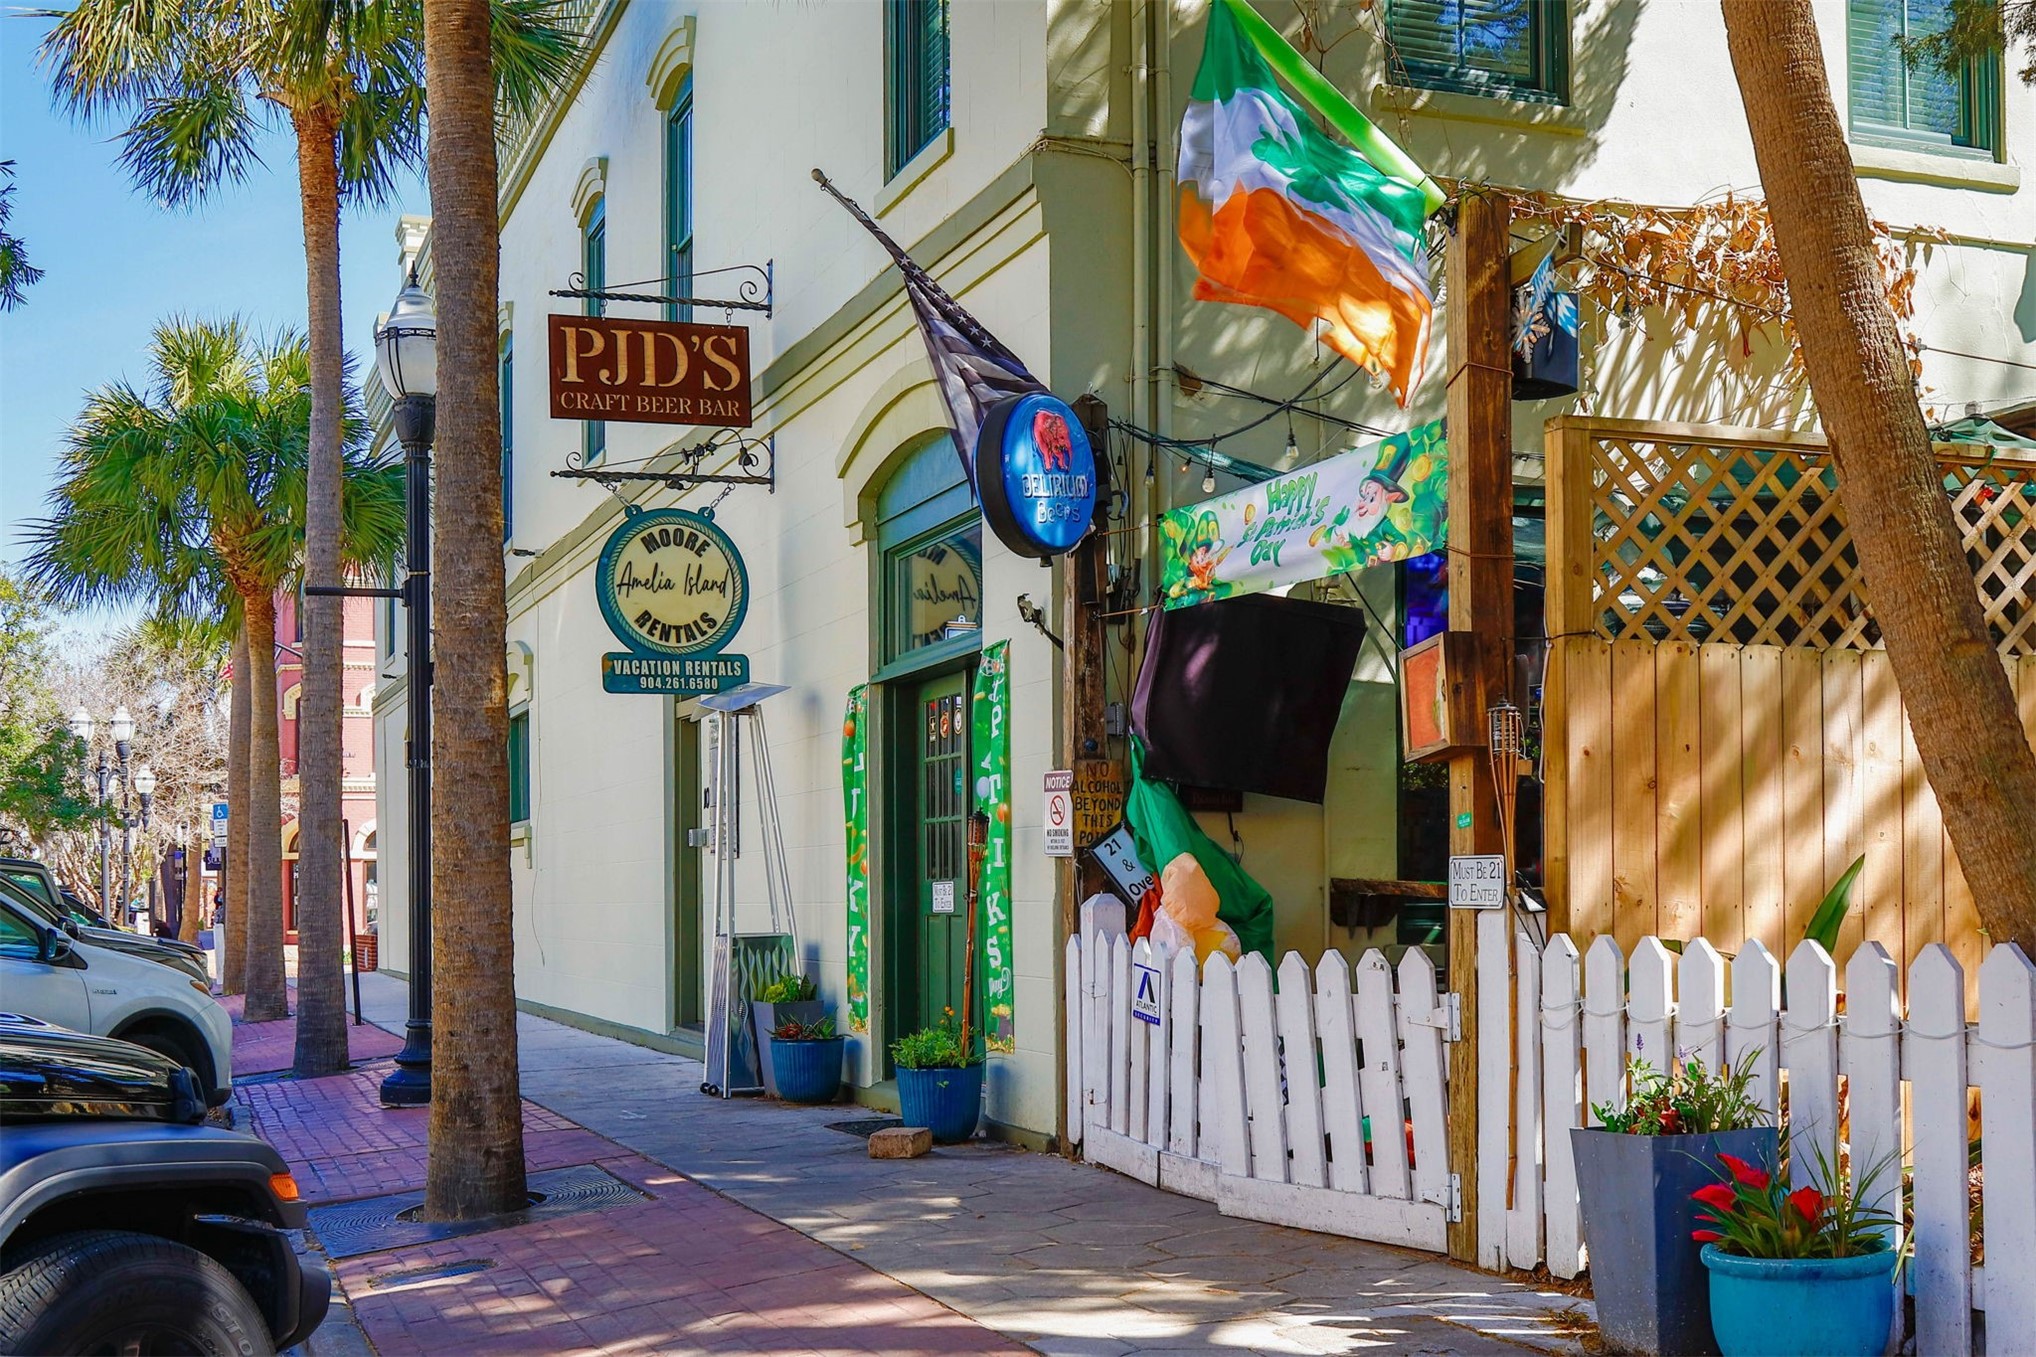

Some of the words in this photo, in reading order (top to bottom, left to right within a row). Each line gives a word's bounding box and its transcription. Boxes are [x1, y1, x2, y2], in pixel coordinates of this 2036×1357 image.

[560, 326, 741, 391] PJD'S
[561, 391, 631, 411] CRAFT
[637, 395, 692, 415] BEER
[700, 399, 740, 417] BAR
[1266, 472, 1318, 515] Happy
[640, 528, 711, 558] MOORE
[1250, 539, 1286, 568] Day
[616, 561, 675, 598] Amelia
[683, 563, 729, 598] Island
[634, 610, 717, 643] RENTALS
[613, 659, 680, 676] VACATION
[685, 660, 741, 676] RENTALS
[640, 677, 718, 690] 904.261.6580
[1086, 761, 1109, 779] NO
[1045, 775, 1071, 789] NOTICE
[1072, 780, 1122, 794] ALCOHOL
[1075, 796, 1120, 812] BEYOND
[1082, 814, 1113, 828] THIS
[1079, 830, 1105, 844] POI
[1104, 838, 1122, 856] 21
[1122, 859, 1136, 872] &
[1489, 861, 1501, 880] 21
[1129, 875, 1155, 896] Ove
[1136, 1000, 1158, 1014] ATLANTIC
